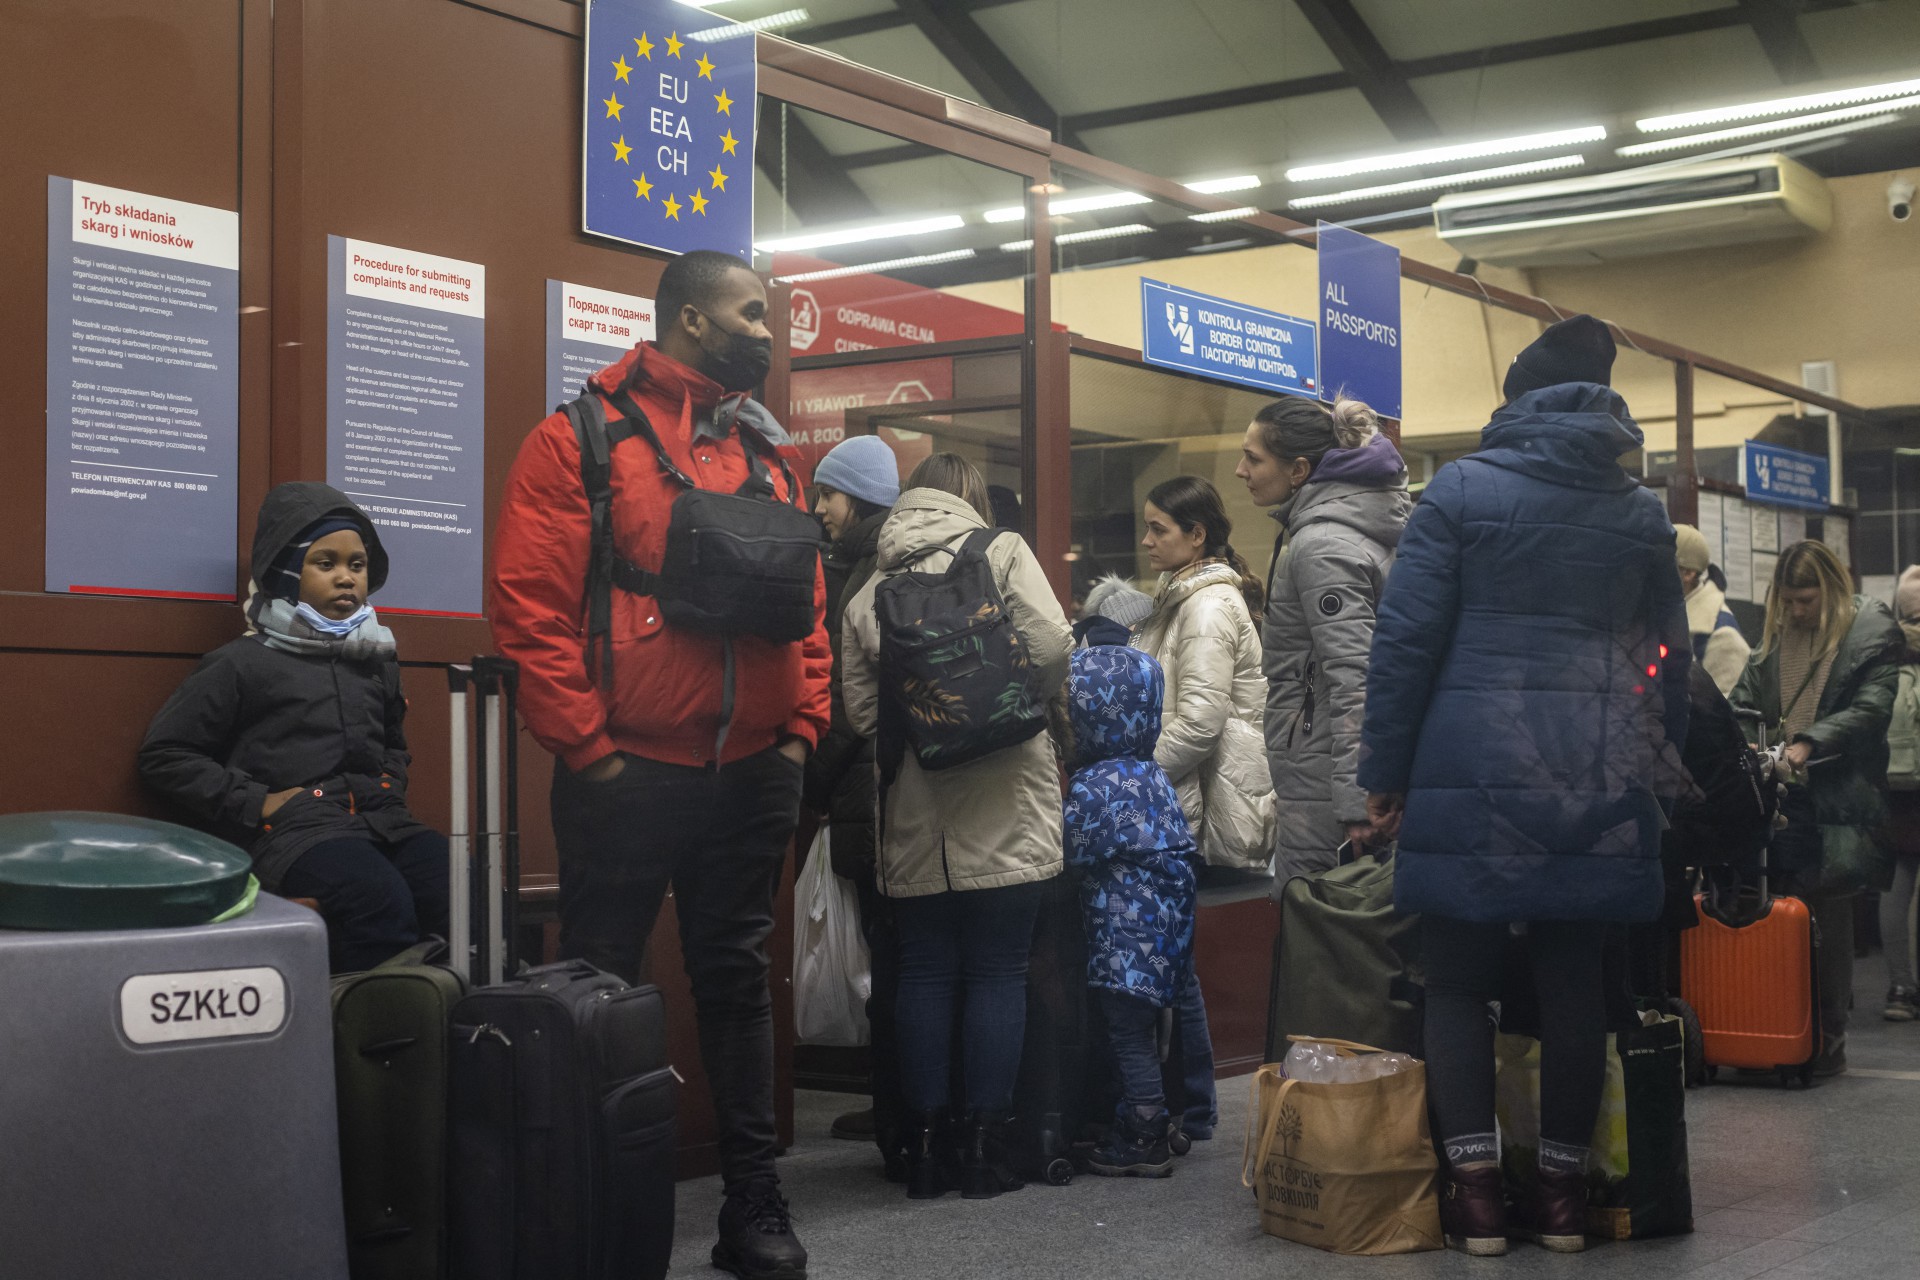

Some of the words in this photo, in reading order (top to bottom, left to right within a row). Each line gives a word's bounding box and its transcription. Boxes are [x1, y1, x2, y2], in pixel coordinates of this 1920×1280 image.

[660, 73, 688, 104] EU
[651, 107, 692, 142] EEA
[658, 146, 688, 176] CH
[82, 196, 111, 214] Tryb
[115, 204, 176, 226] składania
[82, 219, 119, 238] skarg
[122, 225, 126, 236] i
[129, 228, 194, 249] wniosków
[354, 254, 404, 274] Procedure
[406, 265, 419, 276] for
[422, 270, 471, 289] submitting
[354, 272, 406, 290] complaints
[410, 284, 426, 294] and
[430, 289, 469, 302] requests
[1326, 281, 1348, 306] ALL
[569, 296, 609, 315] Порядок
[612, 308, 650, 323] подання
[569, 318, 594, 332] скарг
[597, 323, 606, 333] та
[609, 326, 630, 336] заяв
[837, 307, 896, 335] ODPRAWA
[898, 324, 935, 343] CELNA
[1198, 309, 1243, 332] KONTROLA
[1245, 321, 1292, 344] GRANICZNA
[1326, 308, 1397, 348] PASSPORTS
[1210, 330, 1242, 348] BORDER
[1246, 340, 1283, 359] CONTROL
[1201, 346, 1256, 368] ПАСПОРТНЫЙ
[1258, 359, 1296, 378] КОНТРОЛЬ
[71, 472, 102, 481] TELEFON
[103, 475, 157, 486] INTERWENCYJNY
[197, 484, 208, 492] 000
[372, 506, 398, 514] REVENUE
[398, 509, 442, 519] ADMINISTRATION
[443, 513, 458, 521] (KAS)
[150, 986, 260, 1024] SZKŁO
[1279, 1164, 1323, 1189] ТОРБУЄ
[1268, 1183, 1319, 1211] ДОВКІЛЛЯ
